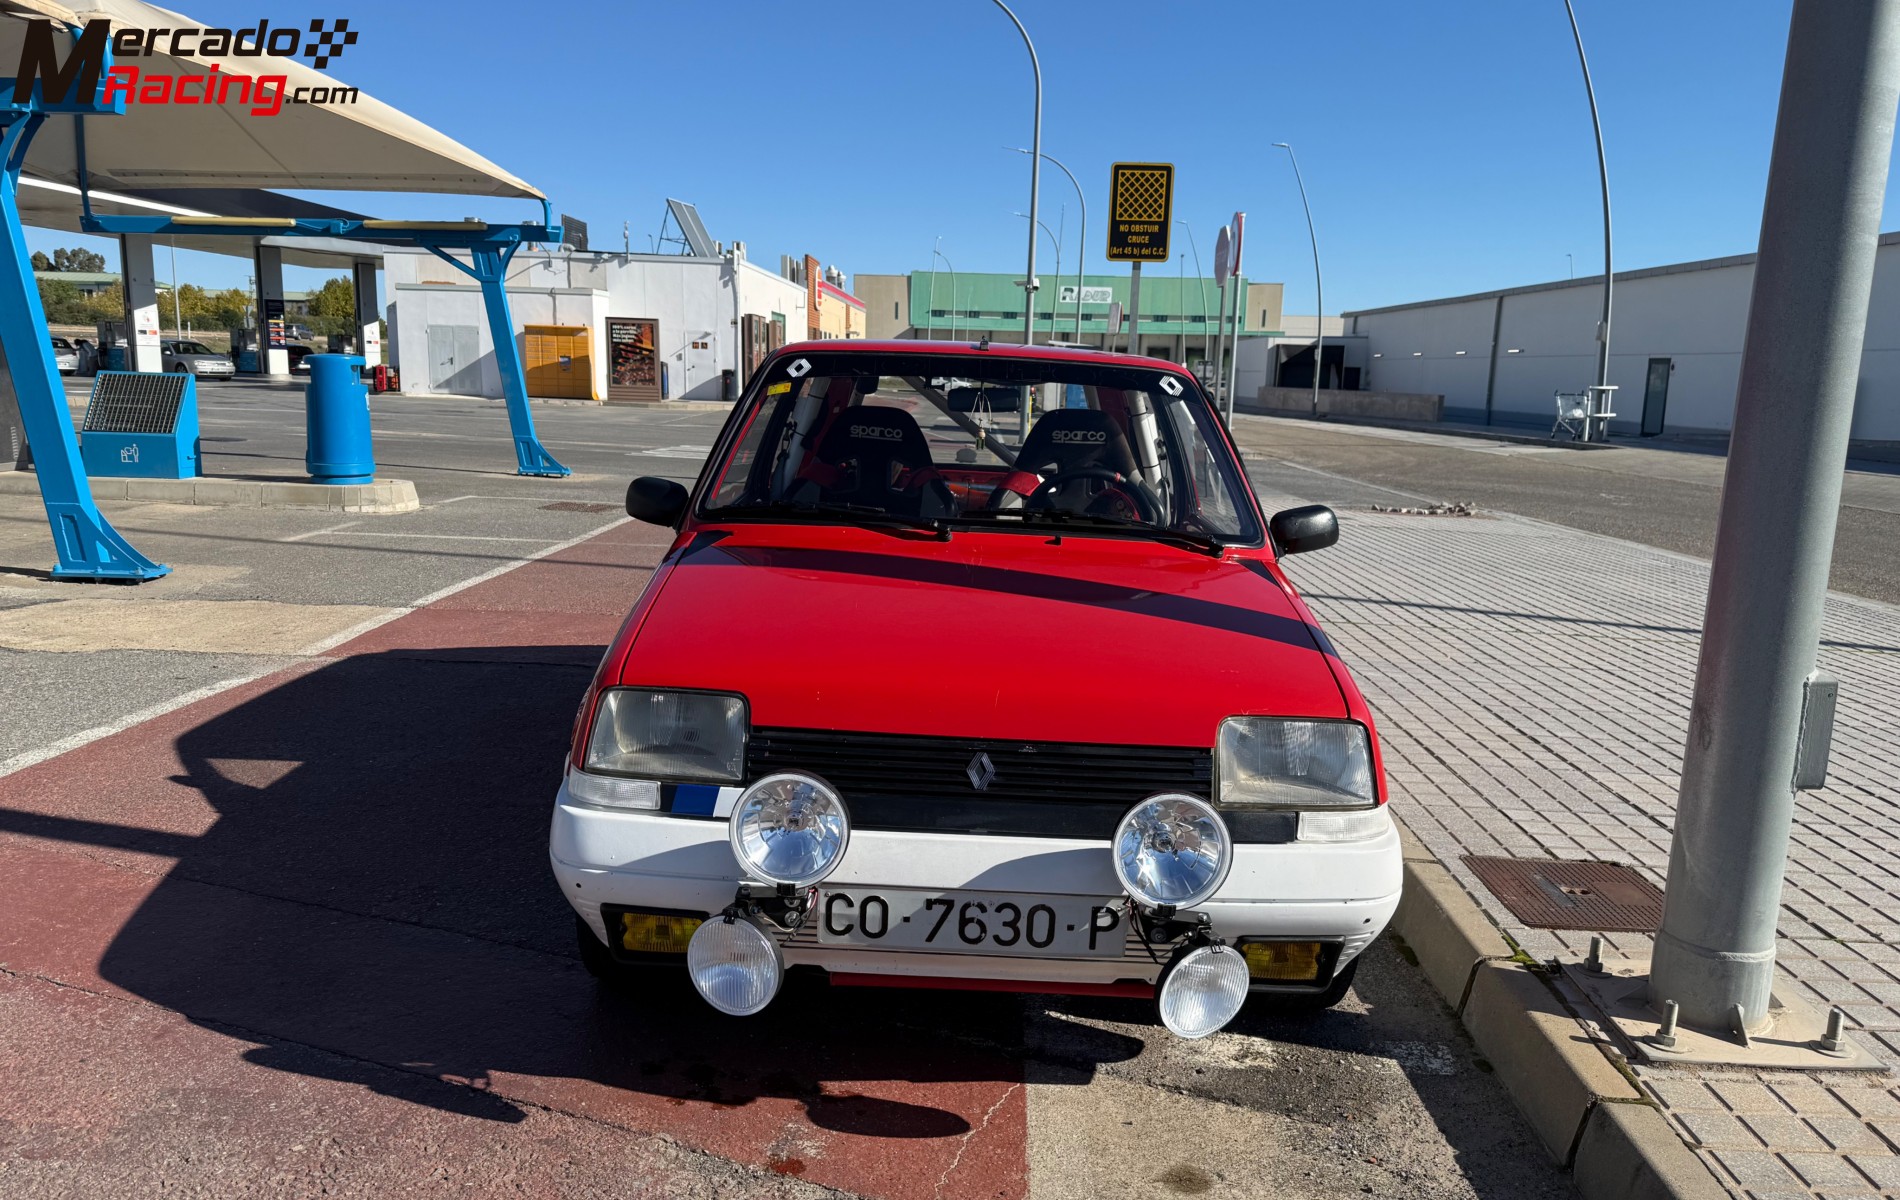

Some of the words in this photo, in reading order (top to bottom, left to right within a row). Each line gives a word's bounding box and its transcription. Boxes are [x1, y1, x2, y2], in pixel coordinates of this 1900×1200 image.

[1119, 224, 1129, 233] NO
[1130, 224, 1159, 233] OBSTUIR
[1127, 235, 1150, 244] CRUCE
[1110, 246, 1123, 257] (Art
[1123, 246, 1132, 255] 45
[1133, 246, 1140, 257] b)
[1141, 247, 1151, 255] del
[850, 425, 903, 439] sparco
[1051, 430, 1107, 443] sparco
